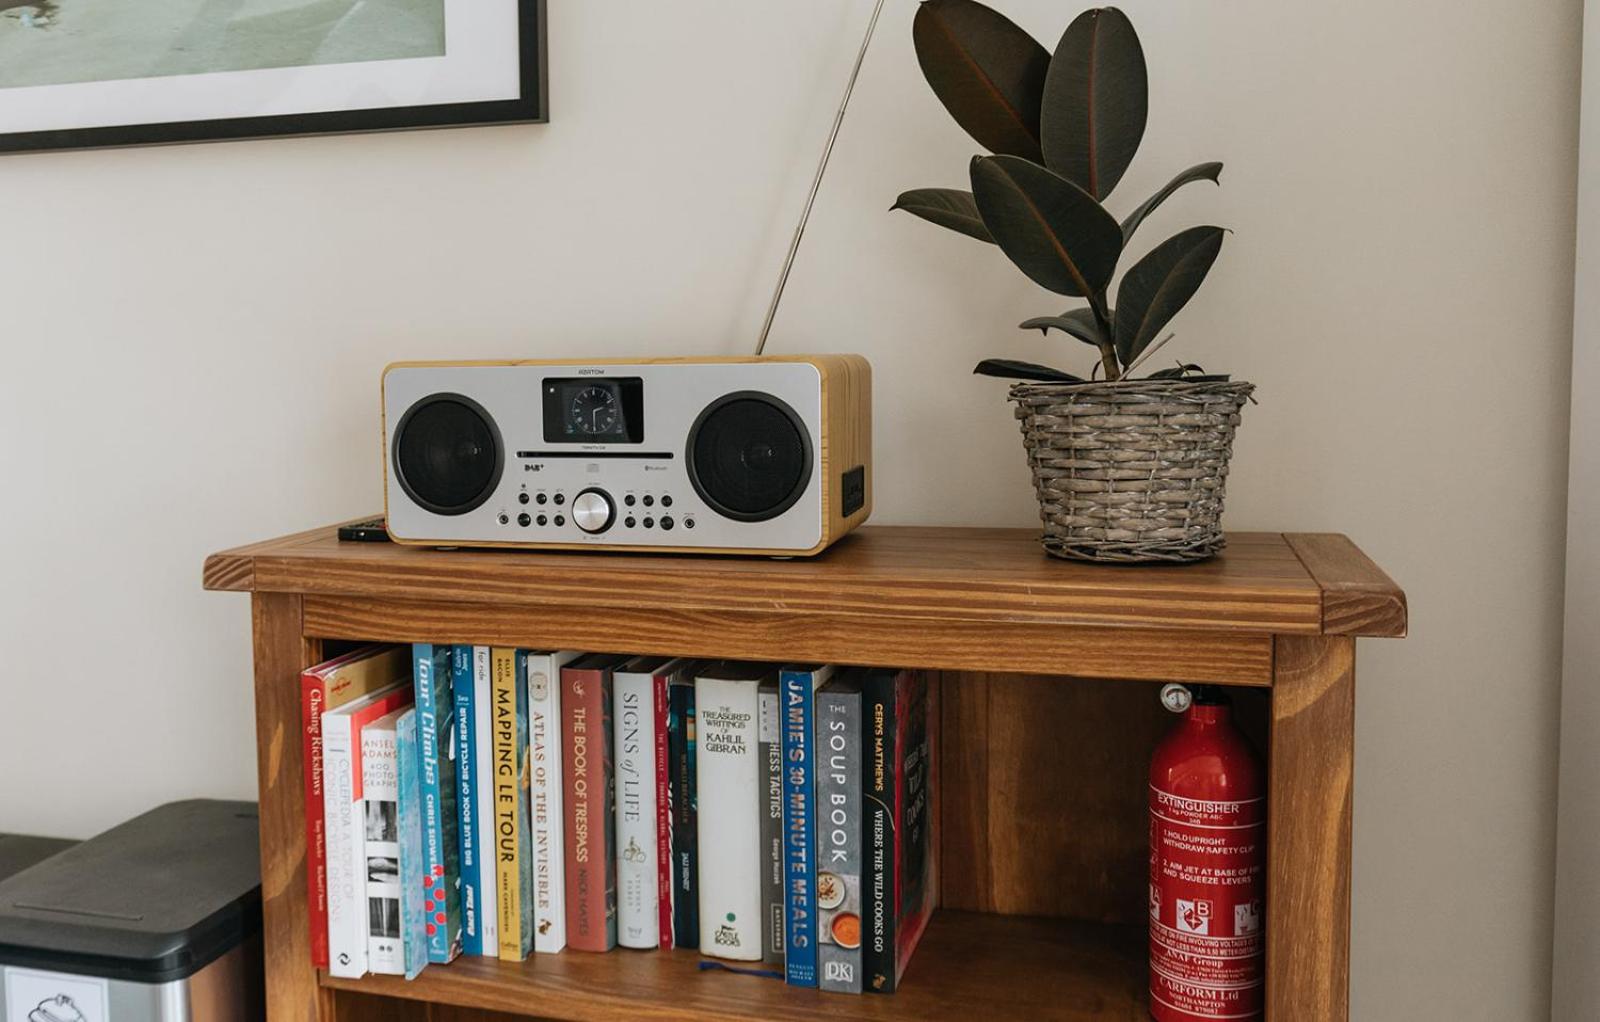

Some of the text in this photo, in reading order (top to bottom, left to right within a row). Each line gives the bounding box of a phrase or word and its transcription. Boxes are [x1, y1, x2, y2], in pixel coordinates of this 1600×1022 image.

[418, 656, 438, 785] Tour Climbs
[702, 711, 751, 721] TREASURED
[829, 705, 847, 714] THE
[459, 707, 469, 742] REPAIR
[705, 719, 746, 729] WRITINGS
[788, 680, 805, 763] JAMIE'S
[307, 689, 323, 796] Chasing Rickshaws
[363, 740, 395, 750] ANSEL
[705, 733, 745, 744] KAHLIL
[705, 743, 747, 754] GIBRAN
[874, 703, 885, 792] CERYS MATTHEWS
[362, 750, 397, 759] ADAMS
[460, 744, 470, 781] BICYCLE
[619, 692, 640, 823] SIGNS of LIFE
[497, 688, 514, 863] MAPPING LE TOUR
[574, 707, 589, 863] THE BOOK OF TRESPASS
[461, 781, 471, 796] OF
[770, 775, 781, 819] TACTICS
[830, 721, 847, 863] SOUP BOOK
[462, 796, 471, 823] BOOK
[534, 712, 549, 909] ATLAS OF THE INVISIBLE
[1157, 792, 1240, 814] EXTINGUISHER
[1180, 810, 1208, 819] POWDER
[789, 766, 806, 874] 30-MINUTE
[427, 793, 439, 882] CHRIS SIDWELLS
[463, 823, 472, 849] BLUE
[1163, 838, 1206, 853] WITHDRAW
[1206, 845, 1238, 855] SAFETY
[1187, 834, 1226, 846] UPRIGHT
[464, 849, 472, 866] BIG
[1169, 861, 1182, 872] AIM
[1183, 865, 1199, 874] JET
[1200, 867, 1212, 876] AT
[1214, 868, 1237, 877] BASE
[1238, 867, 1248, 876] OF
[873, 809, 884, 953] WHERE THE WILD COOKS GO
[1163, 868, 1251, 885] AND SQUEEZE LEVERS
[578, 869, 589, 937] NICK HAYES
[791, 878, 808, 949] MEALS
[1197, 902, 1209, 917] B
[714, 936, 741, 947] BOOKS
[827, 962, 852, 980] DK
[1193, 957, 1224, 969] Group
[1159, 977, 1239, 1001] CARFORM Ltd
[1168, 991, 1226, 1009] NORTHAMPTON
